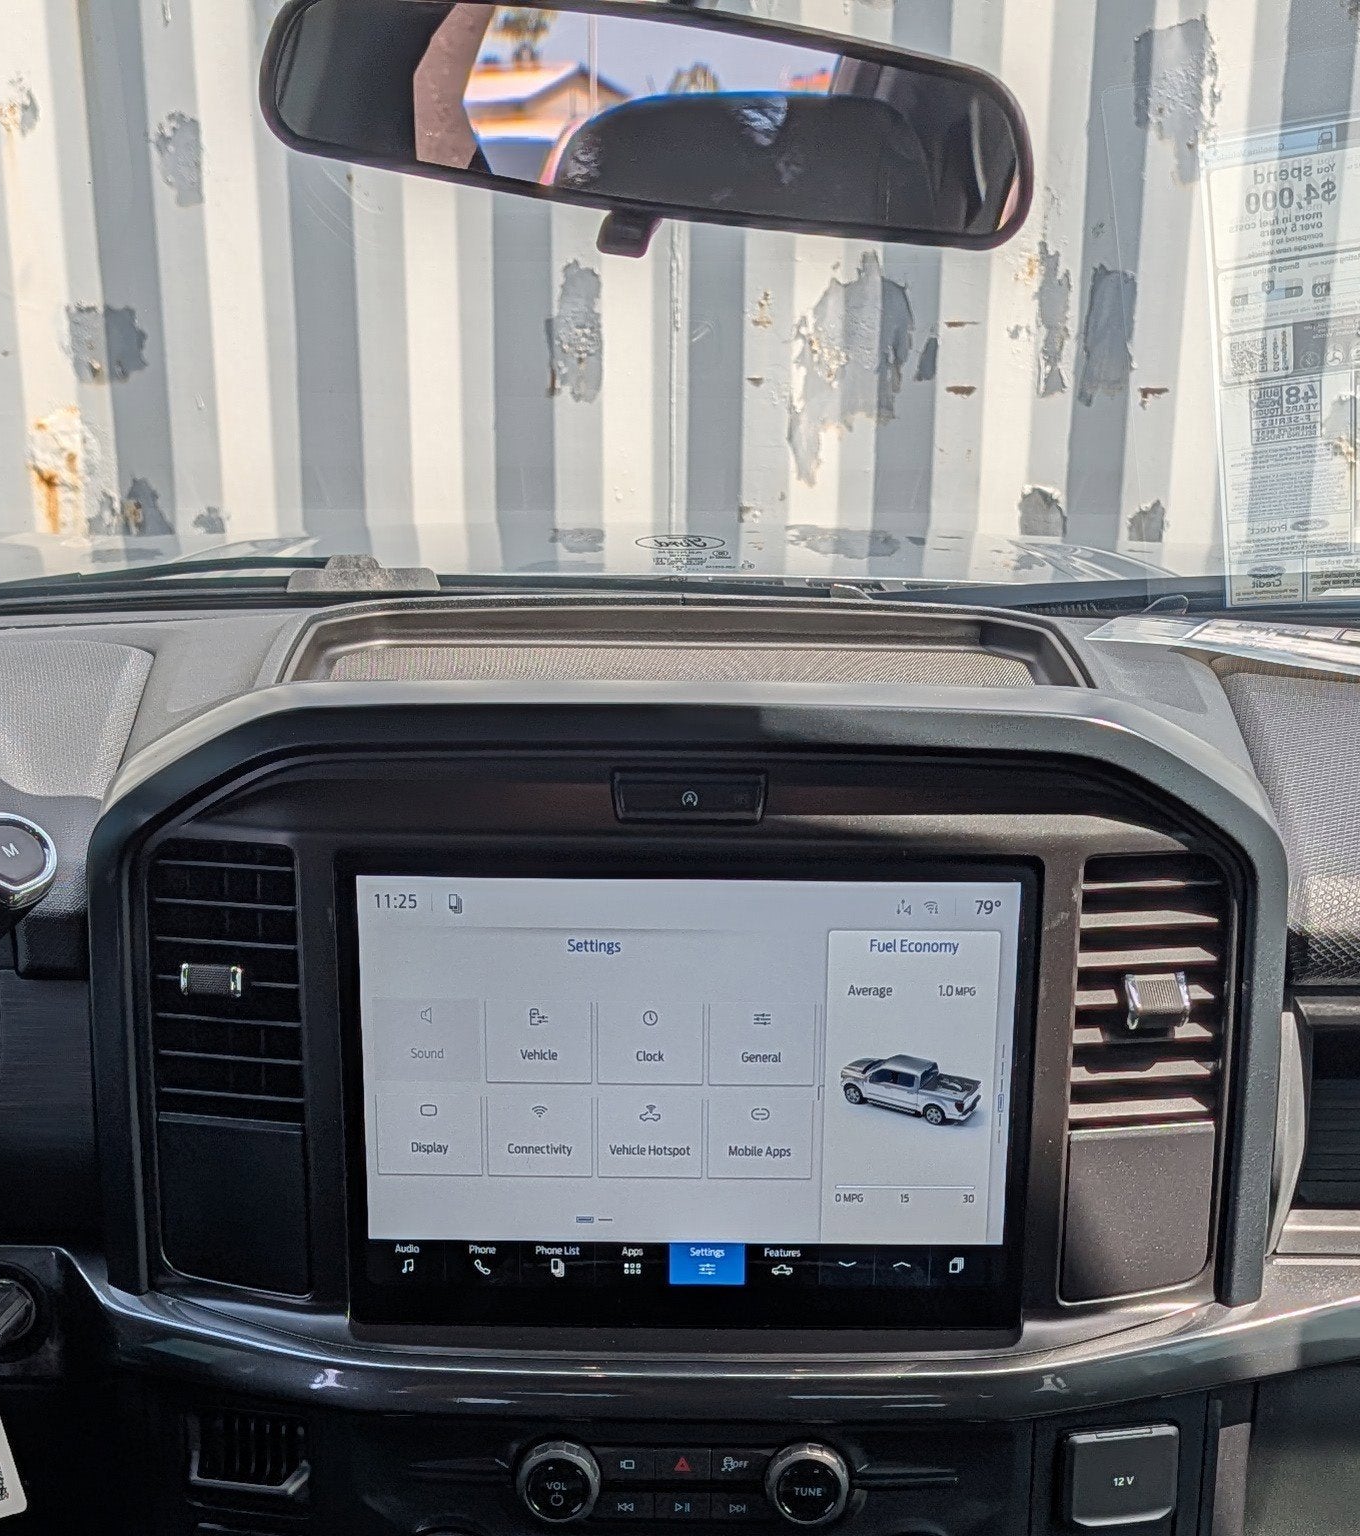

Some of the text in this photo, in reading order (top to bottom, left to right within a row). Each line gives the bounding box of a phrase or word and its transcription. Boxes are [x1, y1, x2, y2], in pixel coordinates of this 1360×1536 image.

[1, 843, 20, 858] M
[374, 894, 417, 909] 11:25
[975, 900, 1001, 915] 79°
[567, 939, 621, 954] Settings
[869, 939, 959, 956] Fuel Economy
[848, 985, 893, 999] Average
[938, 985, 976, 997] 1.0 MPG
[410, 1048, 444, 1059] Sound
[520, 1049, 558, 1061] Vehicle
[636, 1050, 664, 1062] Clock
[741, 1052, 781, 1063] General
[411, 1142, 449, 1155] Display
[507, 1143, 573, 1157] Connectivity
[609, 1144, 691, 1158] Vehicle Hotspot
[728, 1145, 791, 1158] Mobile Apps
[835, 1193, 864, 1203] 0 MPG
[900, 1194, 910, 1204] 15
[962, 1194, 975, 1204] 30
[395, 1244, 420, 1254] Audio
[469, 1244, 496, 1255] Phone
[535, 1245, 580, 1256] Phone List
[622, 1246, 643, 1258] Apps
[690, 1247, 725, 1258] Settings
[764, 1248, 801, 1258] Features
[733, 1460, 749, 1469] OFF
[546, 1482, 568, 1491] VOL
[1113, 1476, 1135, 1487] 12 V
[794, 1487, 823, 1497] TUNE
